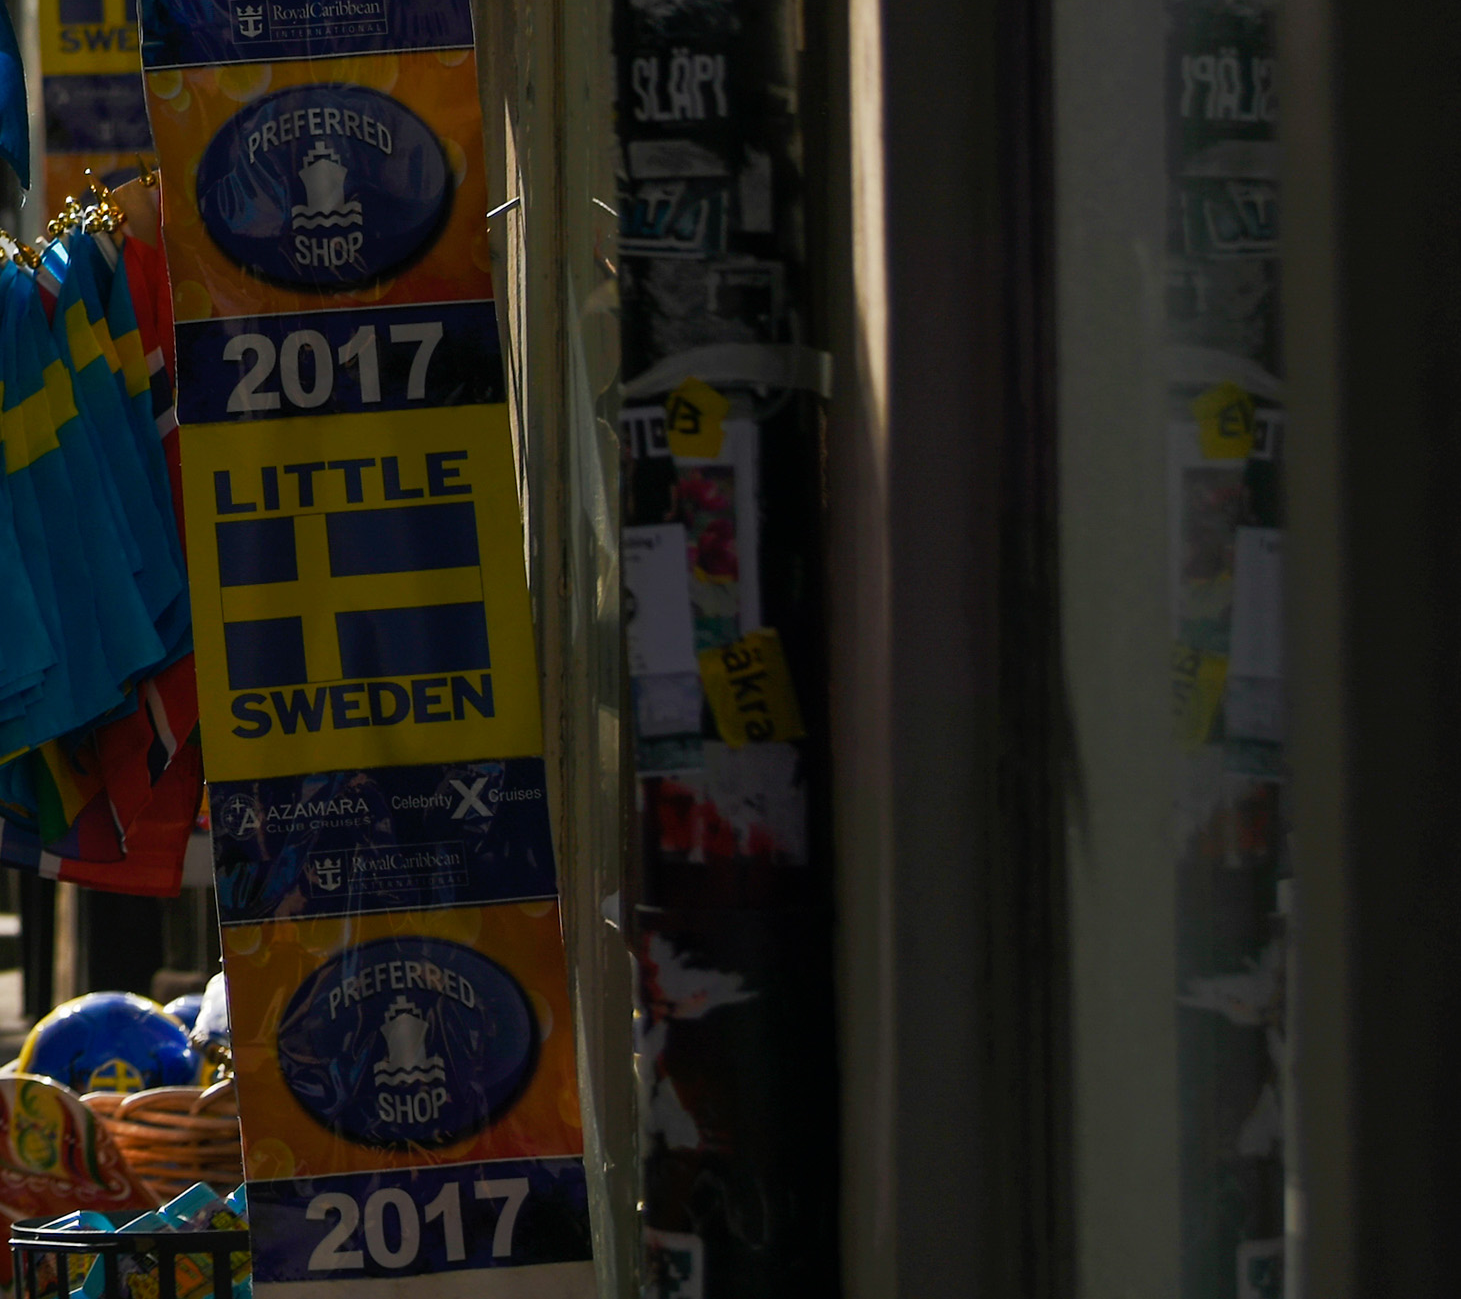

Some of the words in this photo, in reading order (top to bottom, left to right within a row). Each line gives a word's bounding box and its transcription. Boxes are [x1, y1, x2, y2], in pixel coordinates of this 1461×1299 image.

[275, 23, 383, 39] INTERNATIONAL
[246, 107, 393, 164] PREFERRED
[293, 230, 364, 268] SHOP
[222, 320, 444, 414] 2017
[213, 450, 473, 515] LITTLE
[231, 673, 496, 739] SWEDEN
[266, 797, 370, 821] AZAMARA
[391, 793, 453, 810] Celebrity
[488, 787, 542, 803] Cruises
[328, 960, 476, 1020] PREFERRED
[377, 1086, 447, 1125] SHOP
[305, 1177, 530, 1271] 2017
